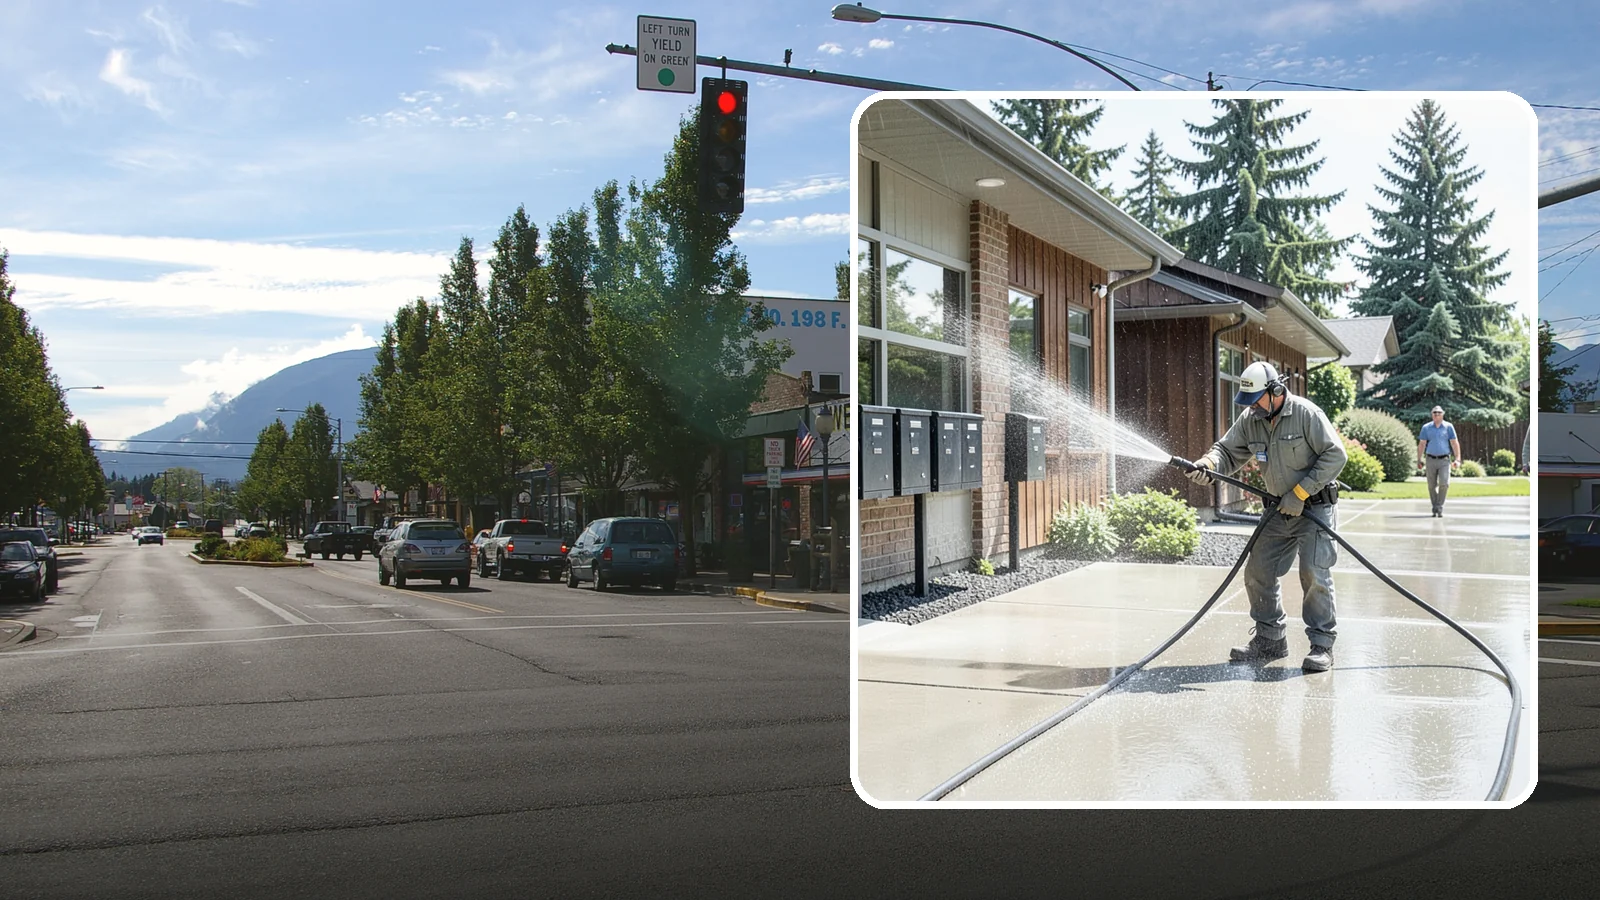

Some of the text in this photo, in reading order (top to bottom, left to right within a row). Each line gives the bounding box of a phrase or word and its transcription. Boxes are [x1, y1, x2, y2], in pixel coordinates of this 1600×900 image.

[643, 24, 690, 36] LEFT TURN
[652, 38, 682, 52] YIELD
[644, 53, 689, 66] ON GREEN
[791, 309, 826, 328] 198
[831, 311, 847, 329] F.
